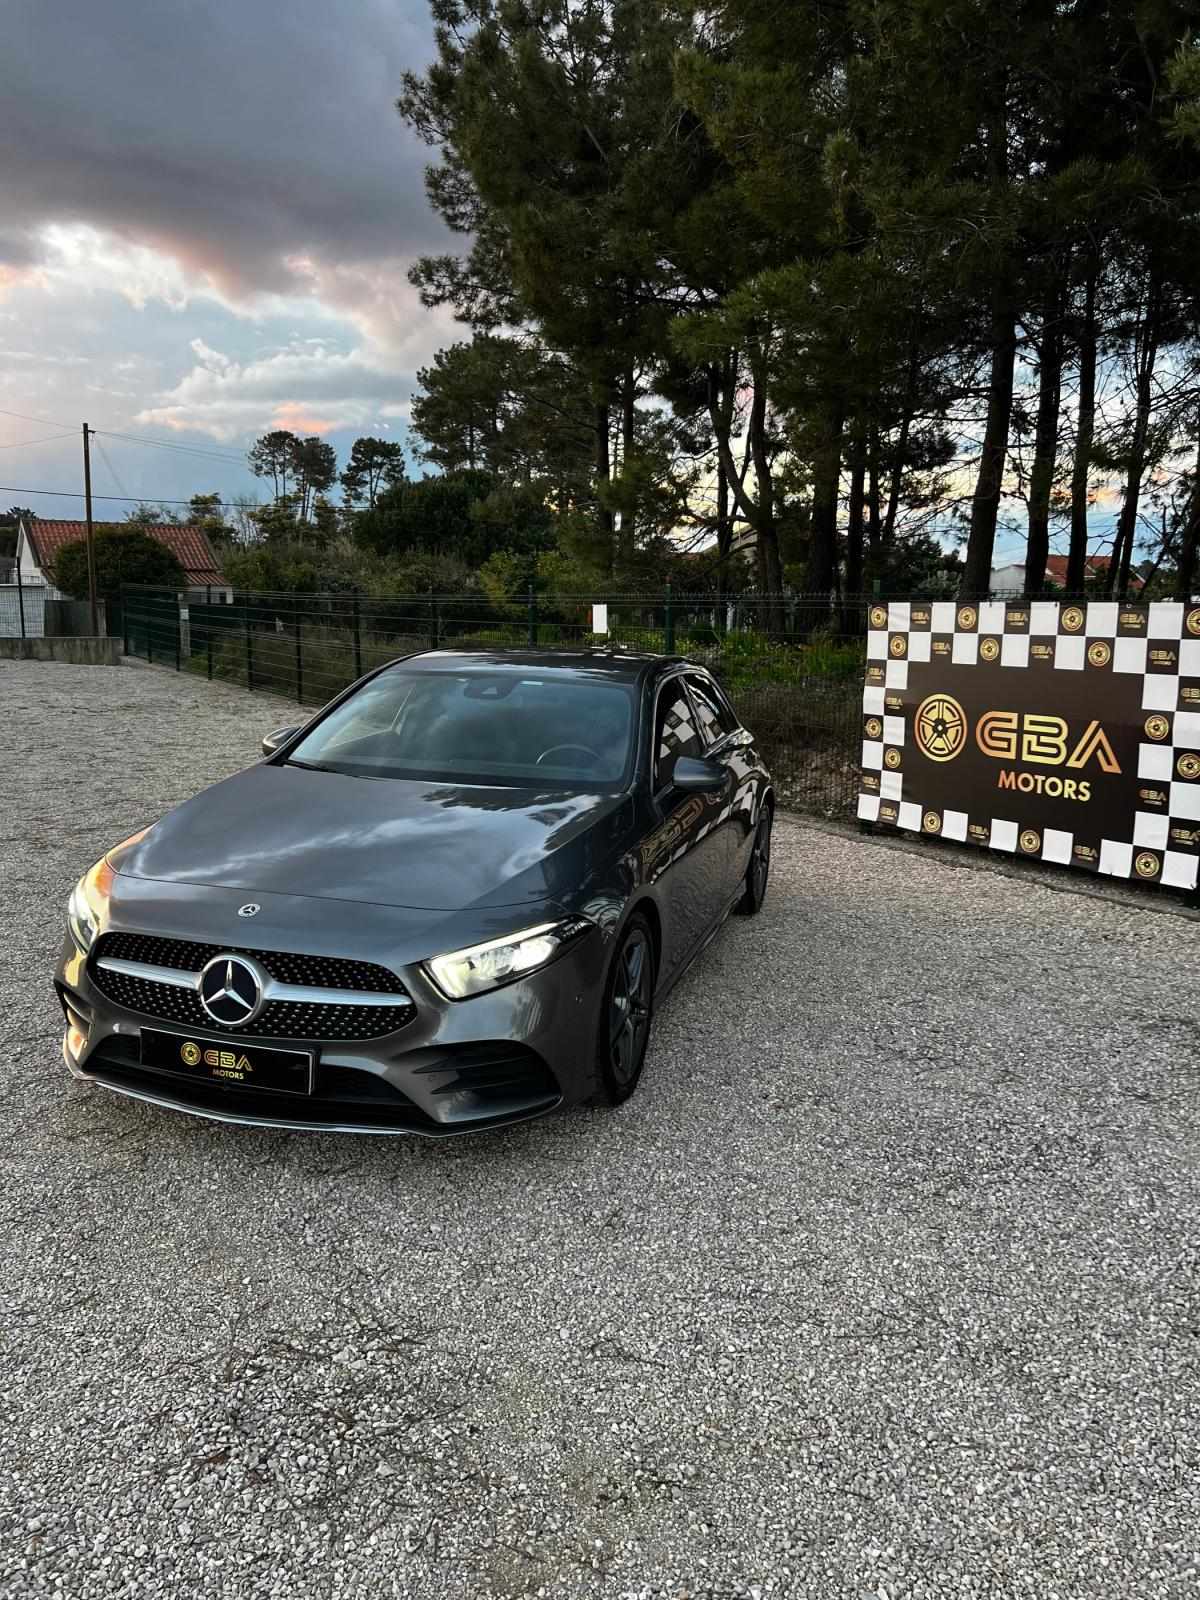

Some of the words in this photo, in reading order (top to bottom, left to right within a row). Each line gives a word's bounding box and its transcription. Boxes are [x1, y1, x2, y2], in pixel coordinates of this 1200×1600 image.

[1180, 687, 1200, 698] GB
[975, 710, 1122, 774] GBA
[997, 769, 1091, 802] MOTORS
[204, 1050, 254, 1072] GBA
[212, 1068, 244, 1080] MOTORS
